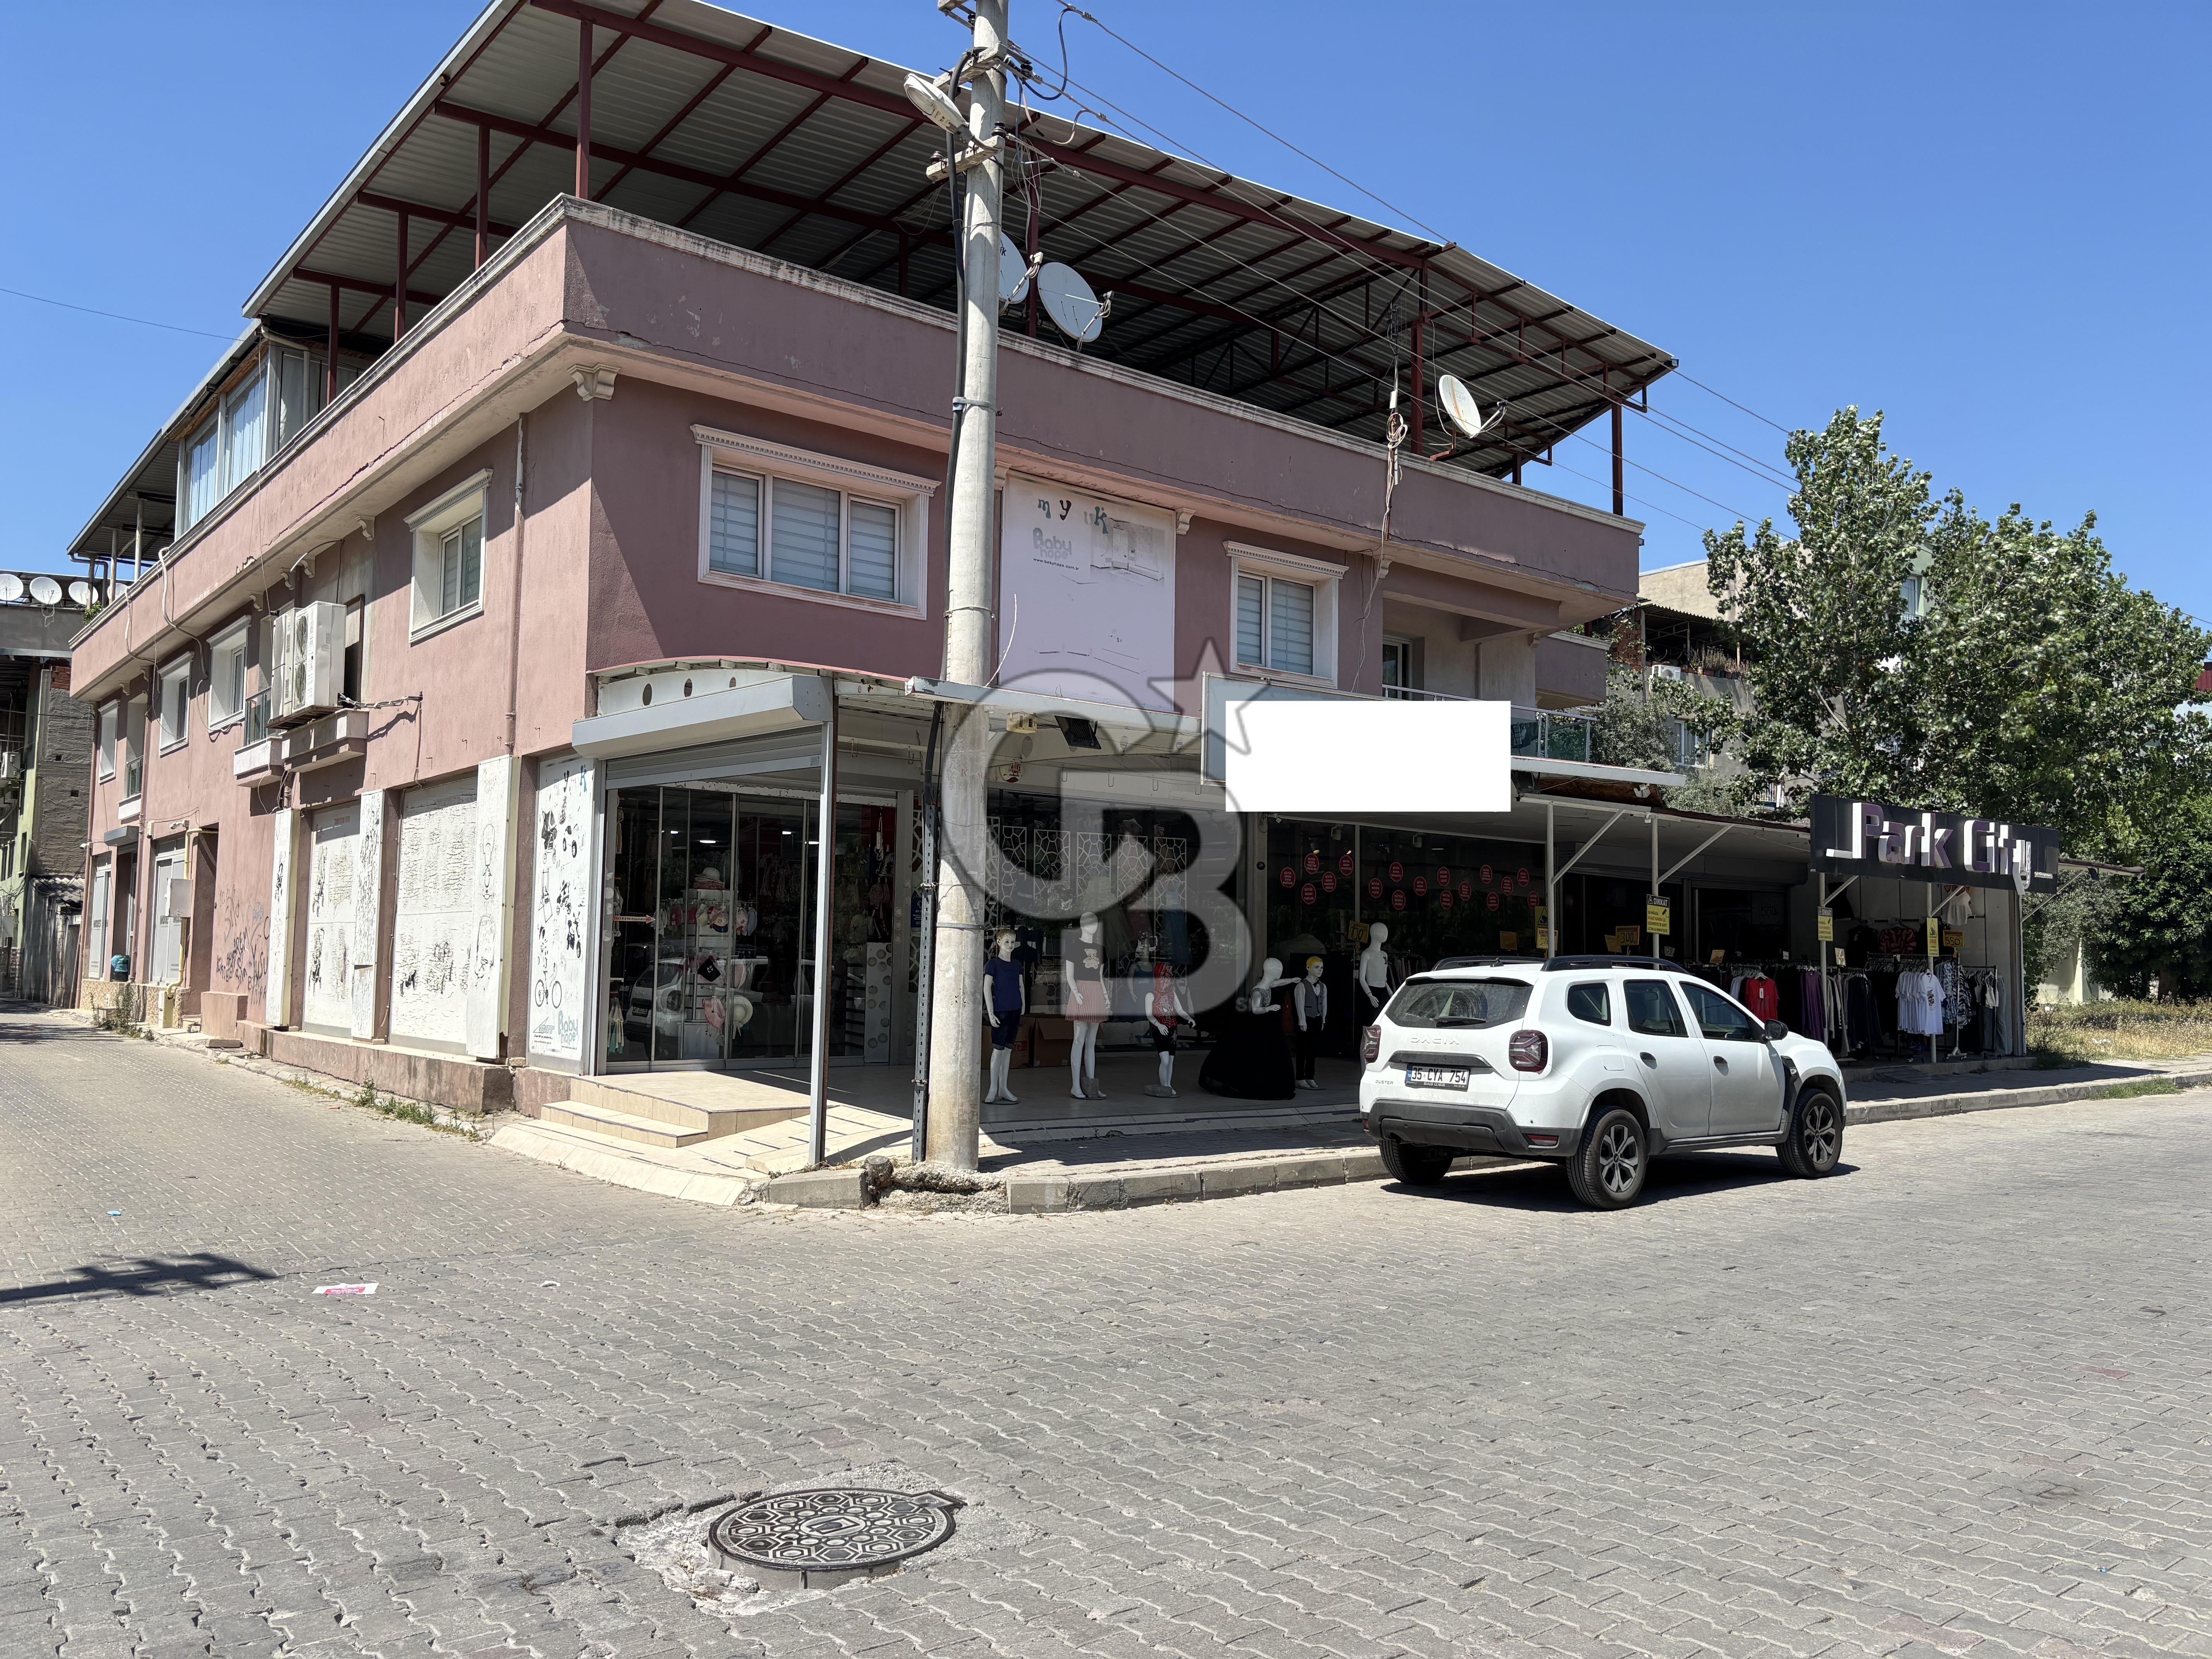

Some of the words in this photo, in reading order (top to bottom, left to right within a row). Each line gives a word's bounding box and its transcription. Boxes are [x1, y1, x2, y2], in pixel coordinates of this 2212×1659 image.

[1033, 527, 1072, 556] Baby
[1040, 546, 1068, 561] hope
[1852, 802, 1953, 868] Park
[1963, 819, 2032, 895] City
[1654, 897, 1668, 907] DİKKAT
[558, 1010, 578, 1036] Baby
[1412, 1067, 1423, 1080] 35
[1427, 1068, 1443, 1082] CYA
[1449, 1070, 1466, 1083] 754
